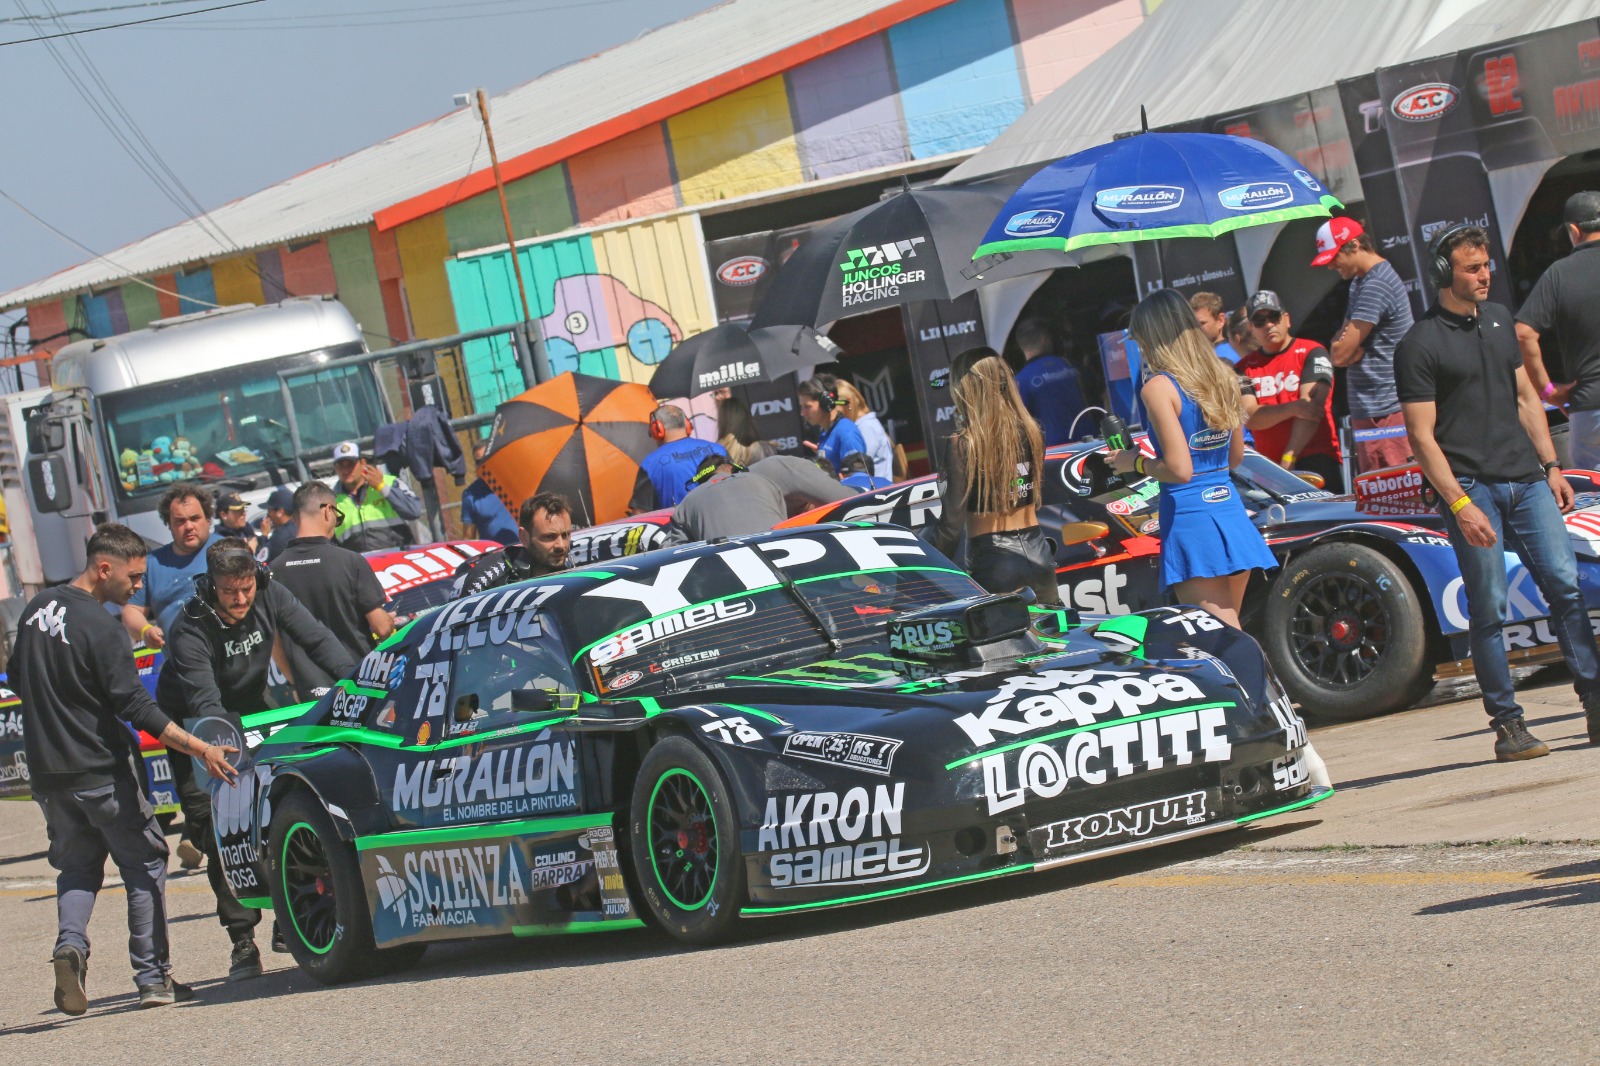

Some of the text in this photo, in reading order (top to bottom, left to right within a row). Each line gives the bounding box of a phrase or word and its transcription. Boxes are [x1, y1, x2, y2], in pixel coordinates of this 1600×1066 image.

[1102, 191, 1175, 202] MURALLÓN
[842, 269, 926, 297] HOLLINGER
[843, 263, 902, 285] JUNCOS
[843, 285, 900, 308] RACING
[573, 317, 582, 329] 3
[698, 361, 760, 384] milla
[700, 371, 761, 389] NEUMATICOS
[1357, 470, 1423, 496] Taborda
[581, 529, 926, 617] YPF
[417, 584, 565, 659] JELUZ
[903, 621, 953, 648] RUS
[1163, 610, 1224, 635] 78
[224, 630, 263, 658] Kappa
[412, 660, 450, 719] 78
[953, 673, 1206, 747] Kappa
[701, 716, 763, 744] 78
[792, 734, 825, 749] OPEN
[829, 738, 846, 753] 25
[852, 740, 875, 757] HS
[392, 727, 576, 812] MURALLÓN
[849, 753, 883, 766] DRUGSTORES
[982, 706, 1232, 816] LOCTITE
[443, 793, 576, 822] EL NOMBRE DE LA PINTURA
[758, 782, 905, 851] AKRON
[1047, 790, 1207, 848] KONJUH
[534, 850, 576, 867] COLLINO
[770, 838, 926, 887] samet
[225, 866, 258, 890] sosa
[404, 842, 529, 912] SCIENZA
[412, 909, 476, 928] FARMACIA
[605, 904, 625, 915] JULIO
